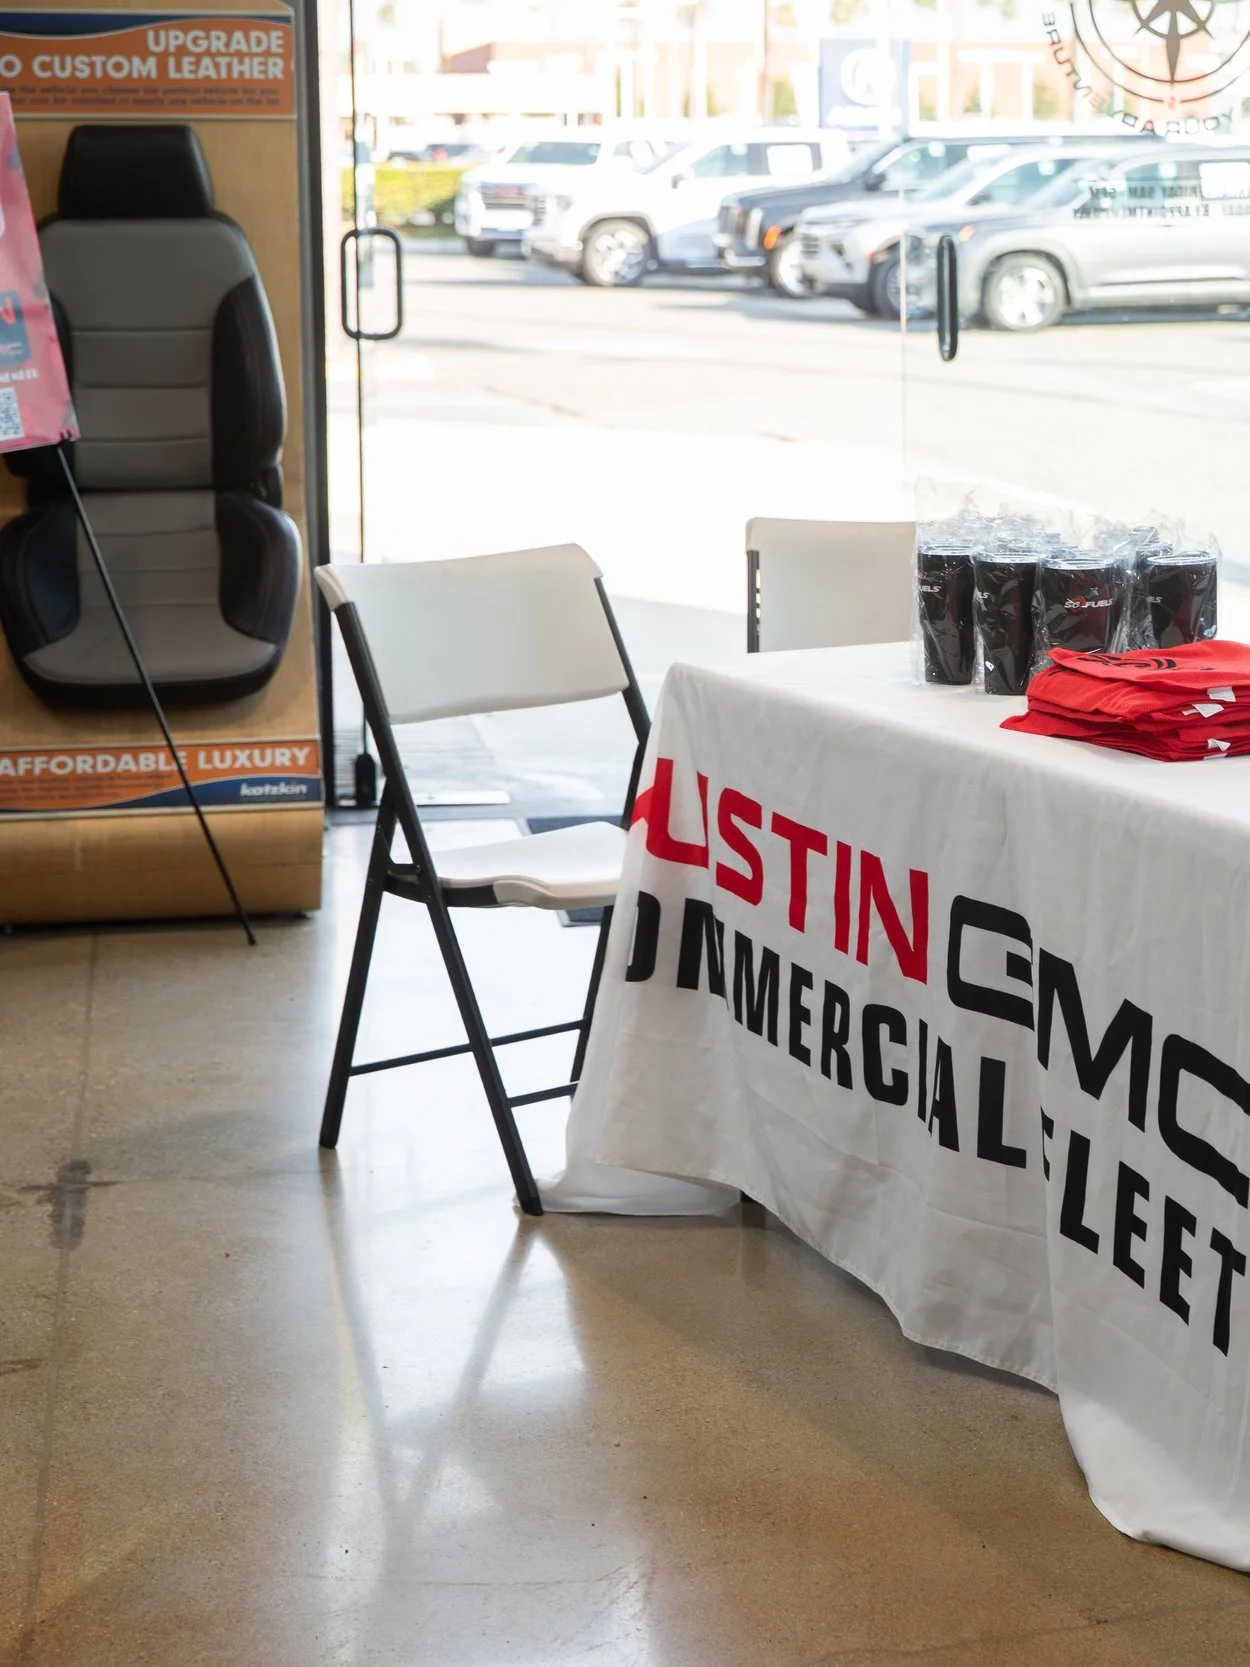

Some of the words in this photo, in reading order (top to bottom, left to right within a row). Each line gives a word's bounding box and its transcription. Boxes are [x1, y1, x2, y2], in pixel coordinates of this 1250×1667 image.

[148, 29, 285, 53] UPGRADE
[32, 55, 157, 78] CUSTOM
[168, 55, 285, 79] LEATHER
[0, 751, 187, 776] AFFORDABLE
[197, 746, 312, 770] LUXURY
[630, 757, 929, 986] USTIN
